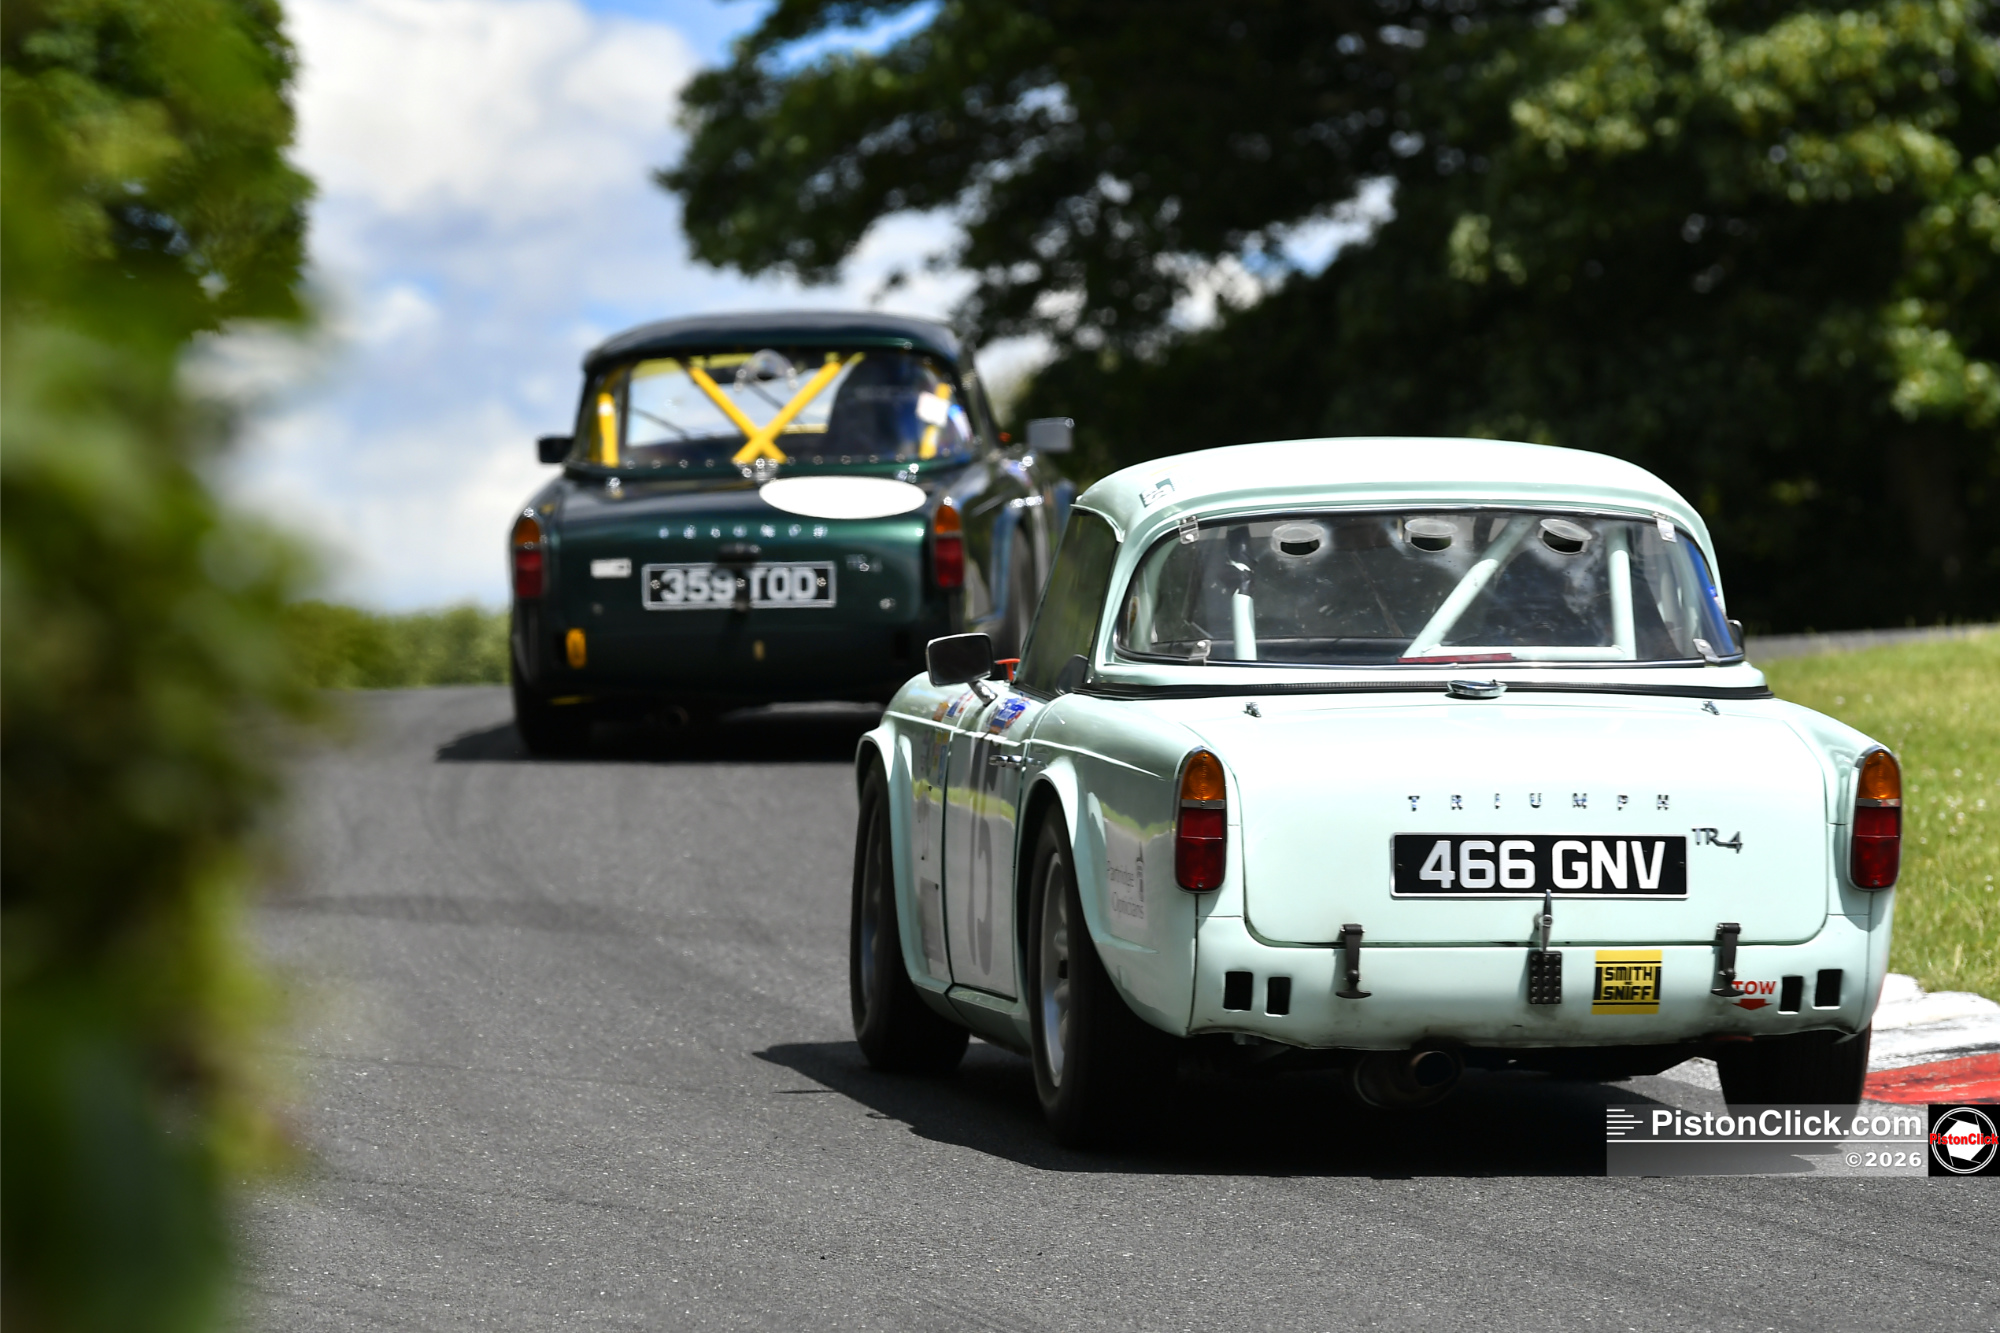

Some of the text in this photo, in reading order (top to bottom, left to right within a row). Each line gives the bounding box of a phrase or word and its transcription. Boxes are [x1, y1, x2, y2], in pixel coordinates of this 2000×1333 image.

[660, 567, 736, 602] 359
[747, 566, 818, 601] TOD
[1408, 793, 1669, 812] TRIUMPH
[1691, 827, 1743, 853] TR4
[1419, 840, 1666, 889] 466 GNV
[1604, 966, 1653, 982] SMITH
[1603, 985, 1652, 1001] SNIFF
[1731, 981, 1776, 995] TOW
